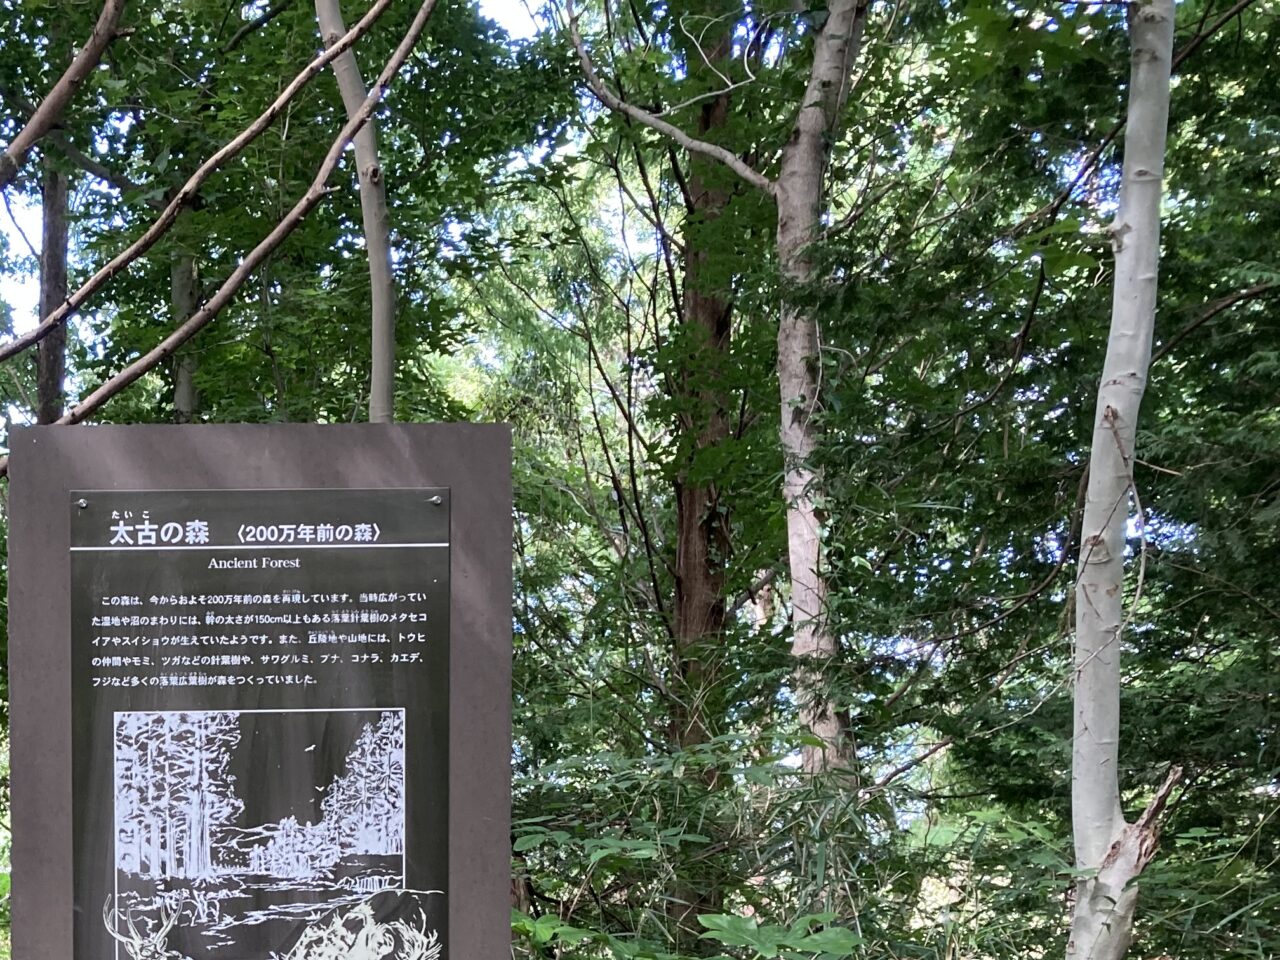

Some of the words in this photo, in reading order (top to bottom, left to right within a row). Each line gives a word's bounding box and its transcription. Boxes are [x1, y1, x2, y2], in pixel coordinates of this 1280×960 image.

[109, 519, 210, 545] 太古の森
[208, 557, 258, 569] Ancient
[261, 556, 301, 569] Forest
